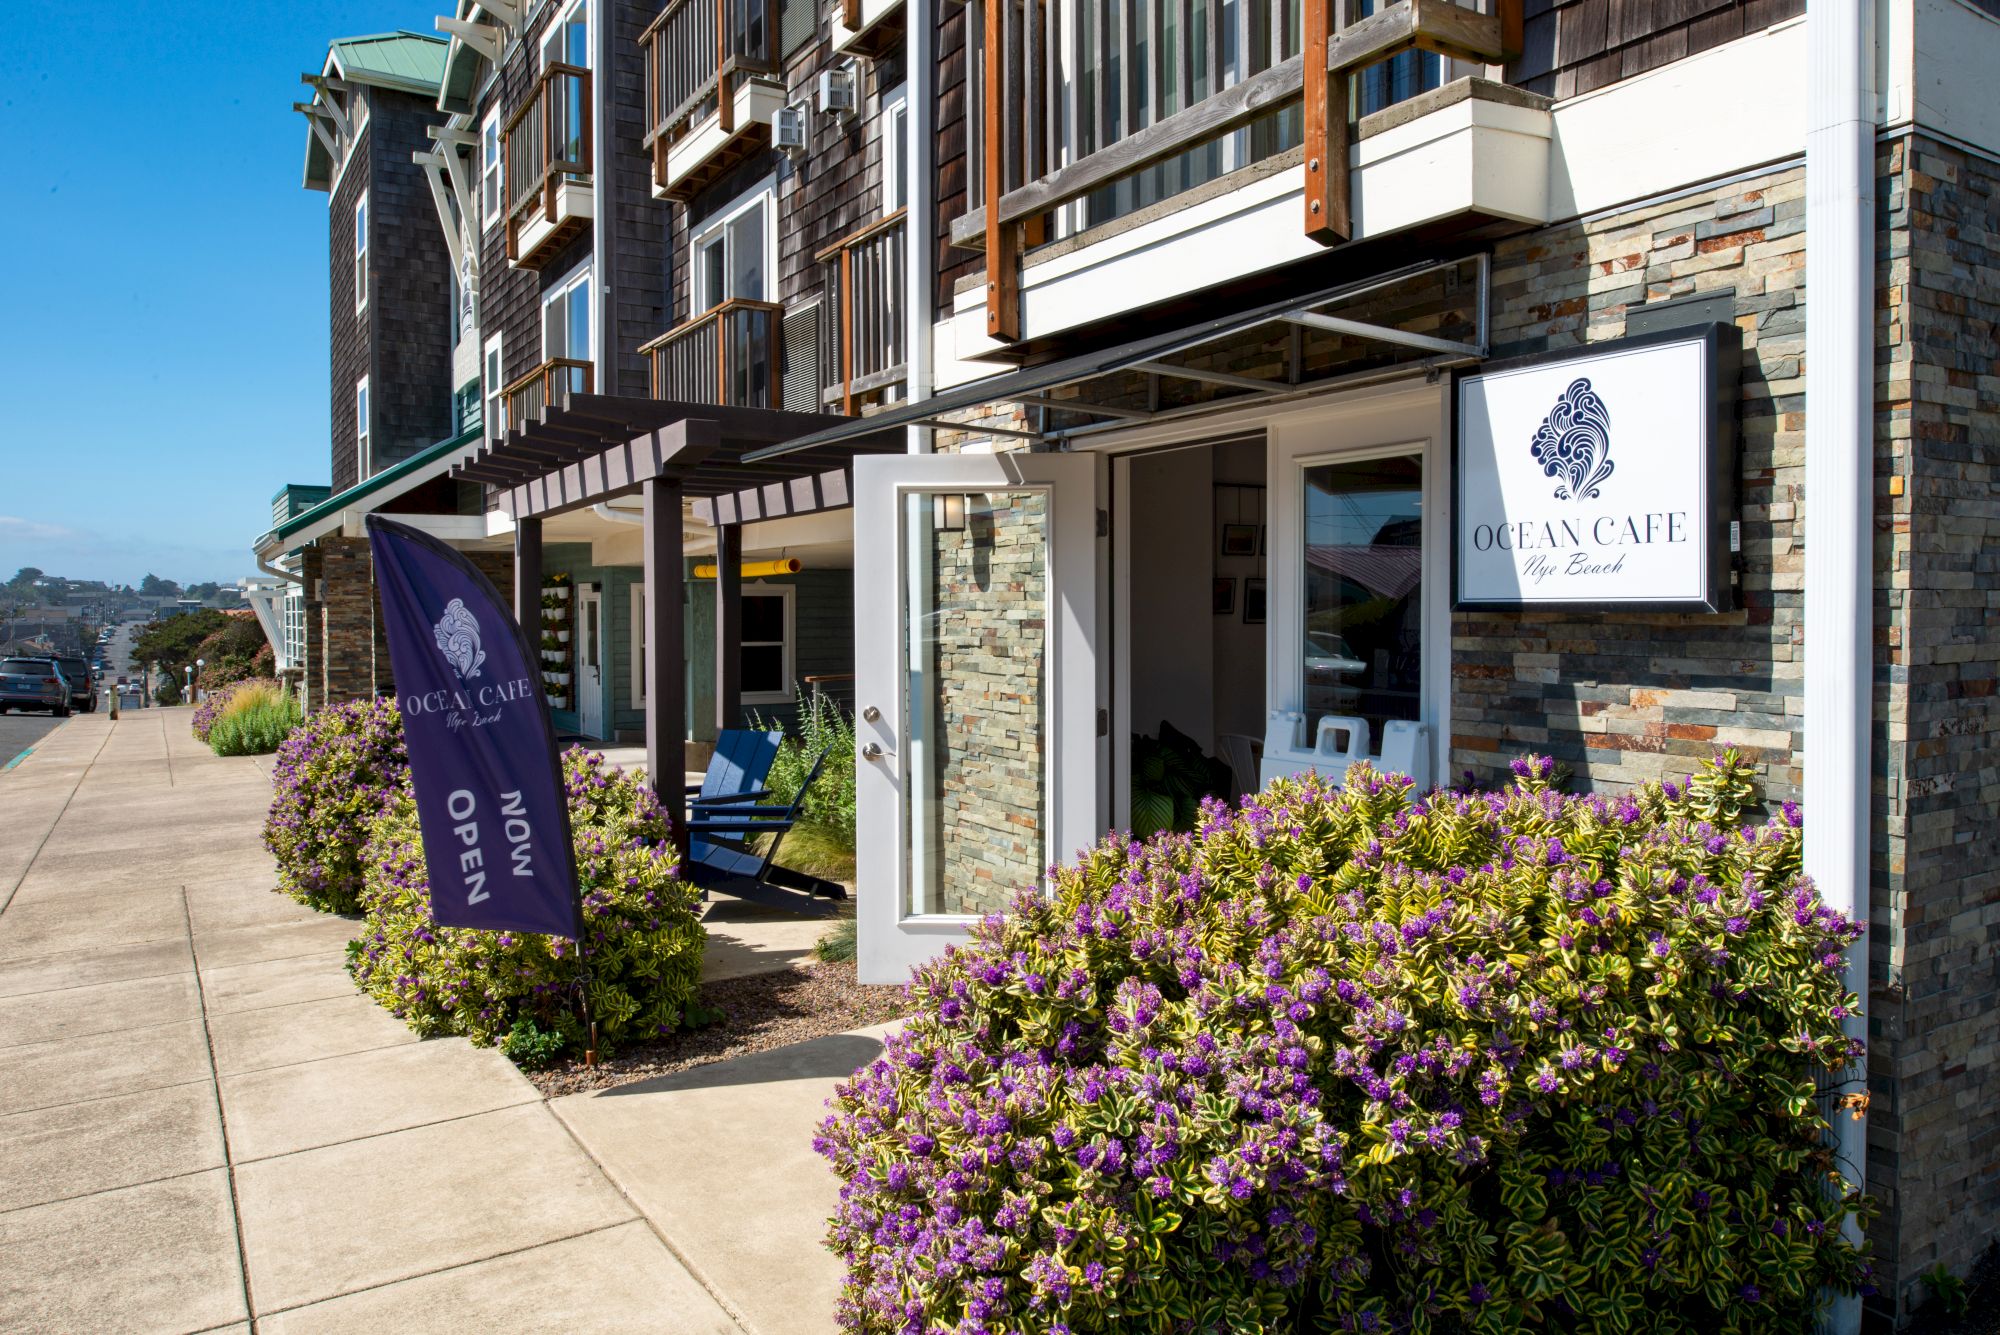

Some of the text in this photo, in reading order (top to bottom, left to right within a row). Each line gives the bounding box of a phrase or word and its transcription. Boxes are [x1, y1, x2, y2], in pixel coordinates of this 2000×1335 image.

[1474, 511, 1687, 552] OCEAN CAFE
[1523, 551, 1626, 585] Nye Beach
[406, 678, 532, 716] OCEAN CAFE
[447, 789, 491, 906] OPEN
[500, 789, 534, 877] NOW
